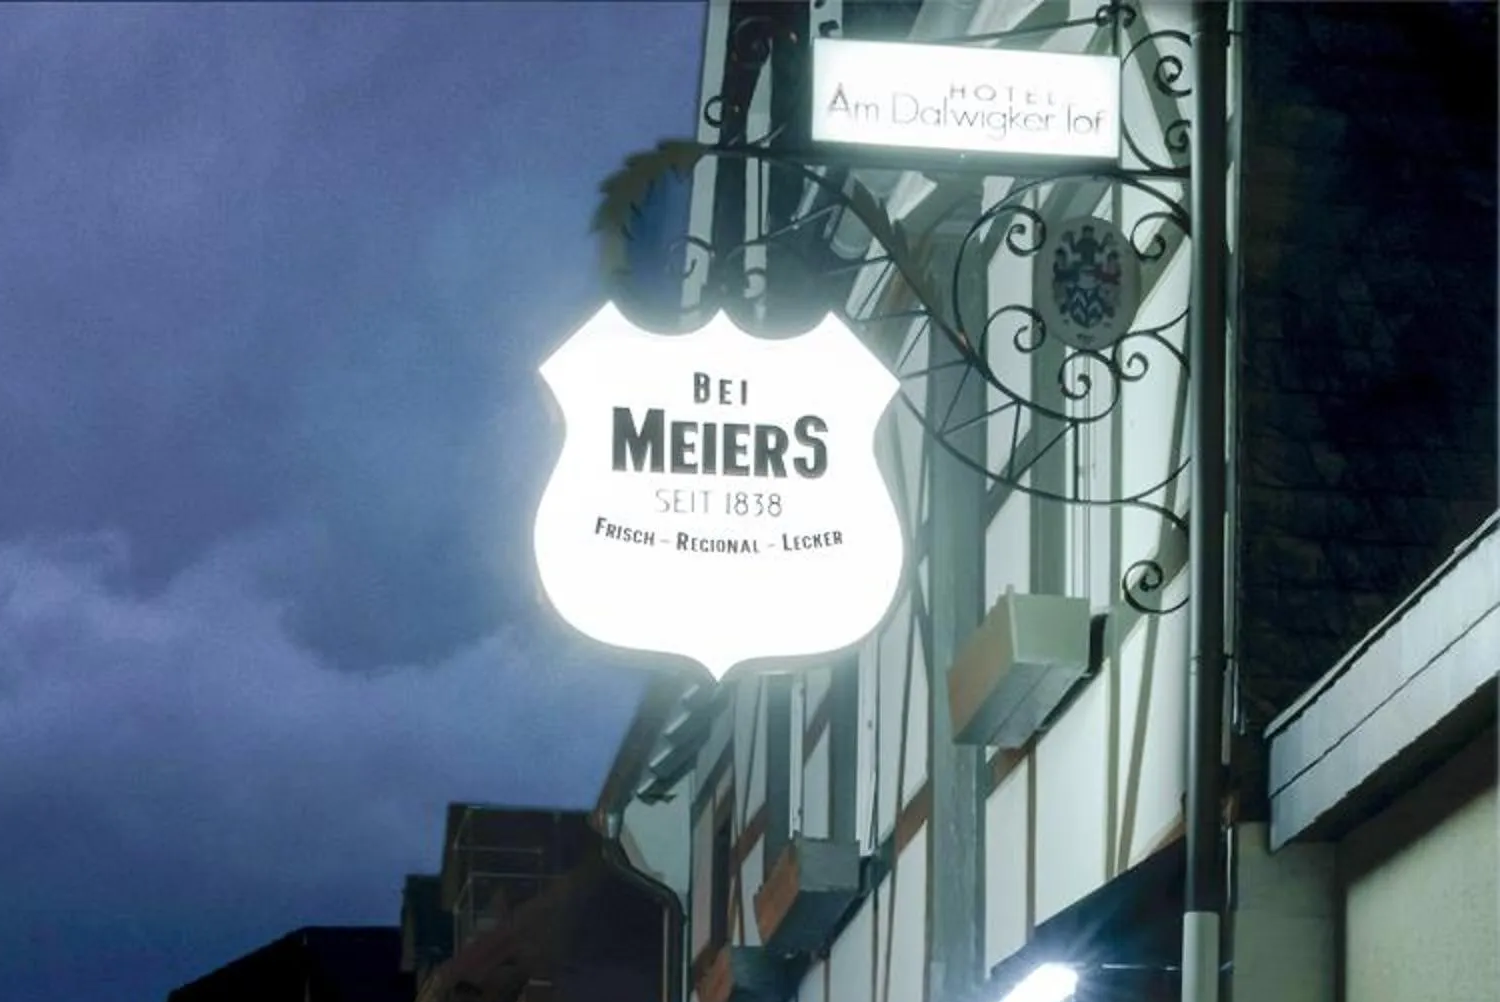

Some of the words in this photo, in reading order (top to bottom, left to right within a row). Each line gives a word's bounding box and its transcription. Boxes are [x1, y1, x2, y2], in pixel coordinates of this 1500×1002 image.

[827, 82, 880, 122] Am
[892, 92, 1057, 142] Dalwigker
[949, 82, 1057, 107] HOTEL
[692, 371, 749, 406] BEI
[611, 405, 830, 481] MEIERS
[654, 488, 714, 515] SEIT
[725, 491, 783, 518] 1838
[594, 515, 656, 547] FRISCH
[676, 531, 761, 554] REGIONAL
[781, 529, 844, 552] LECKER
